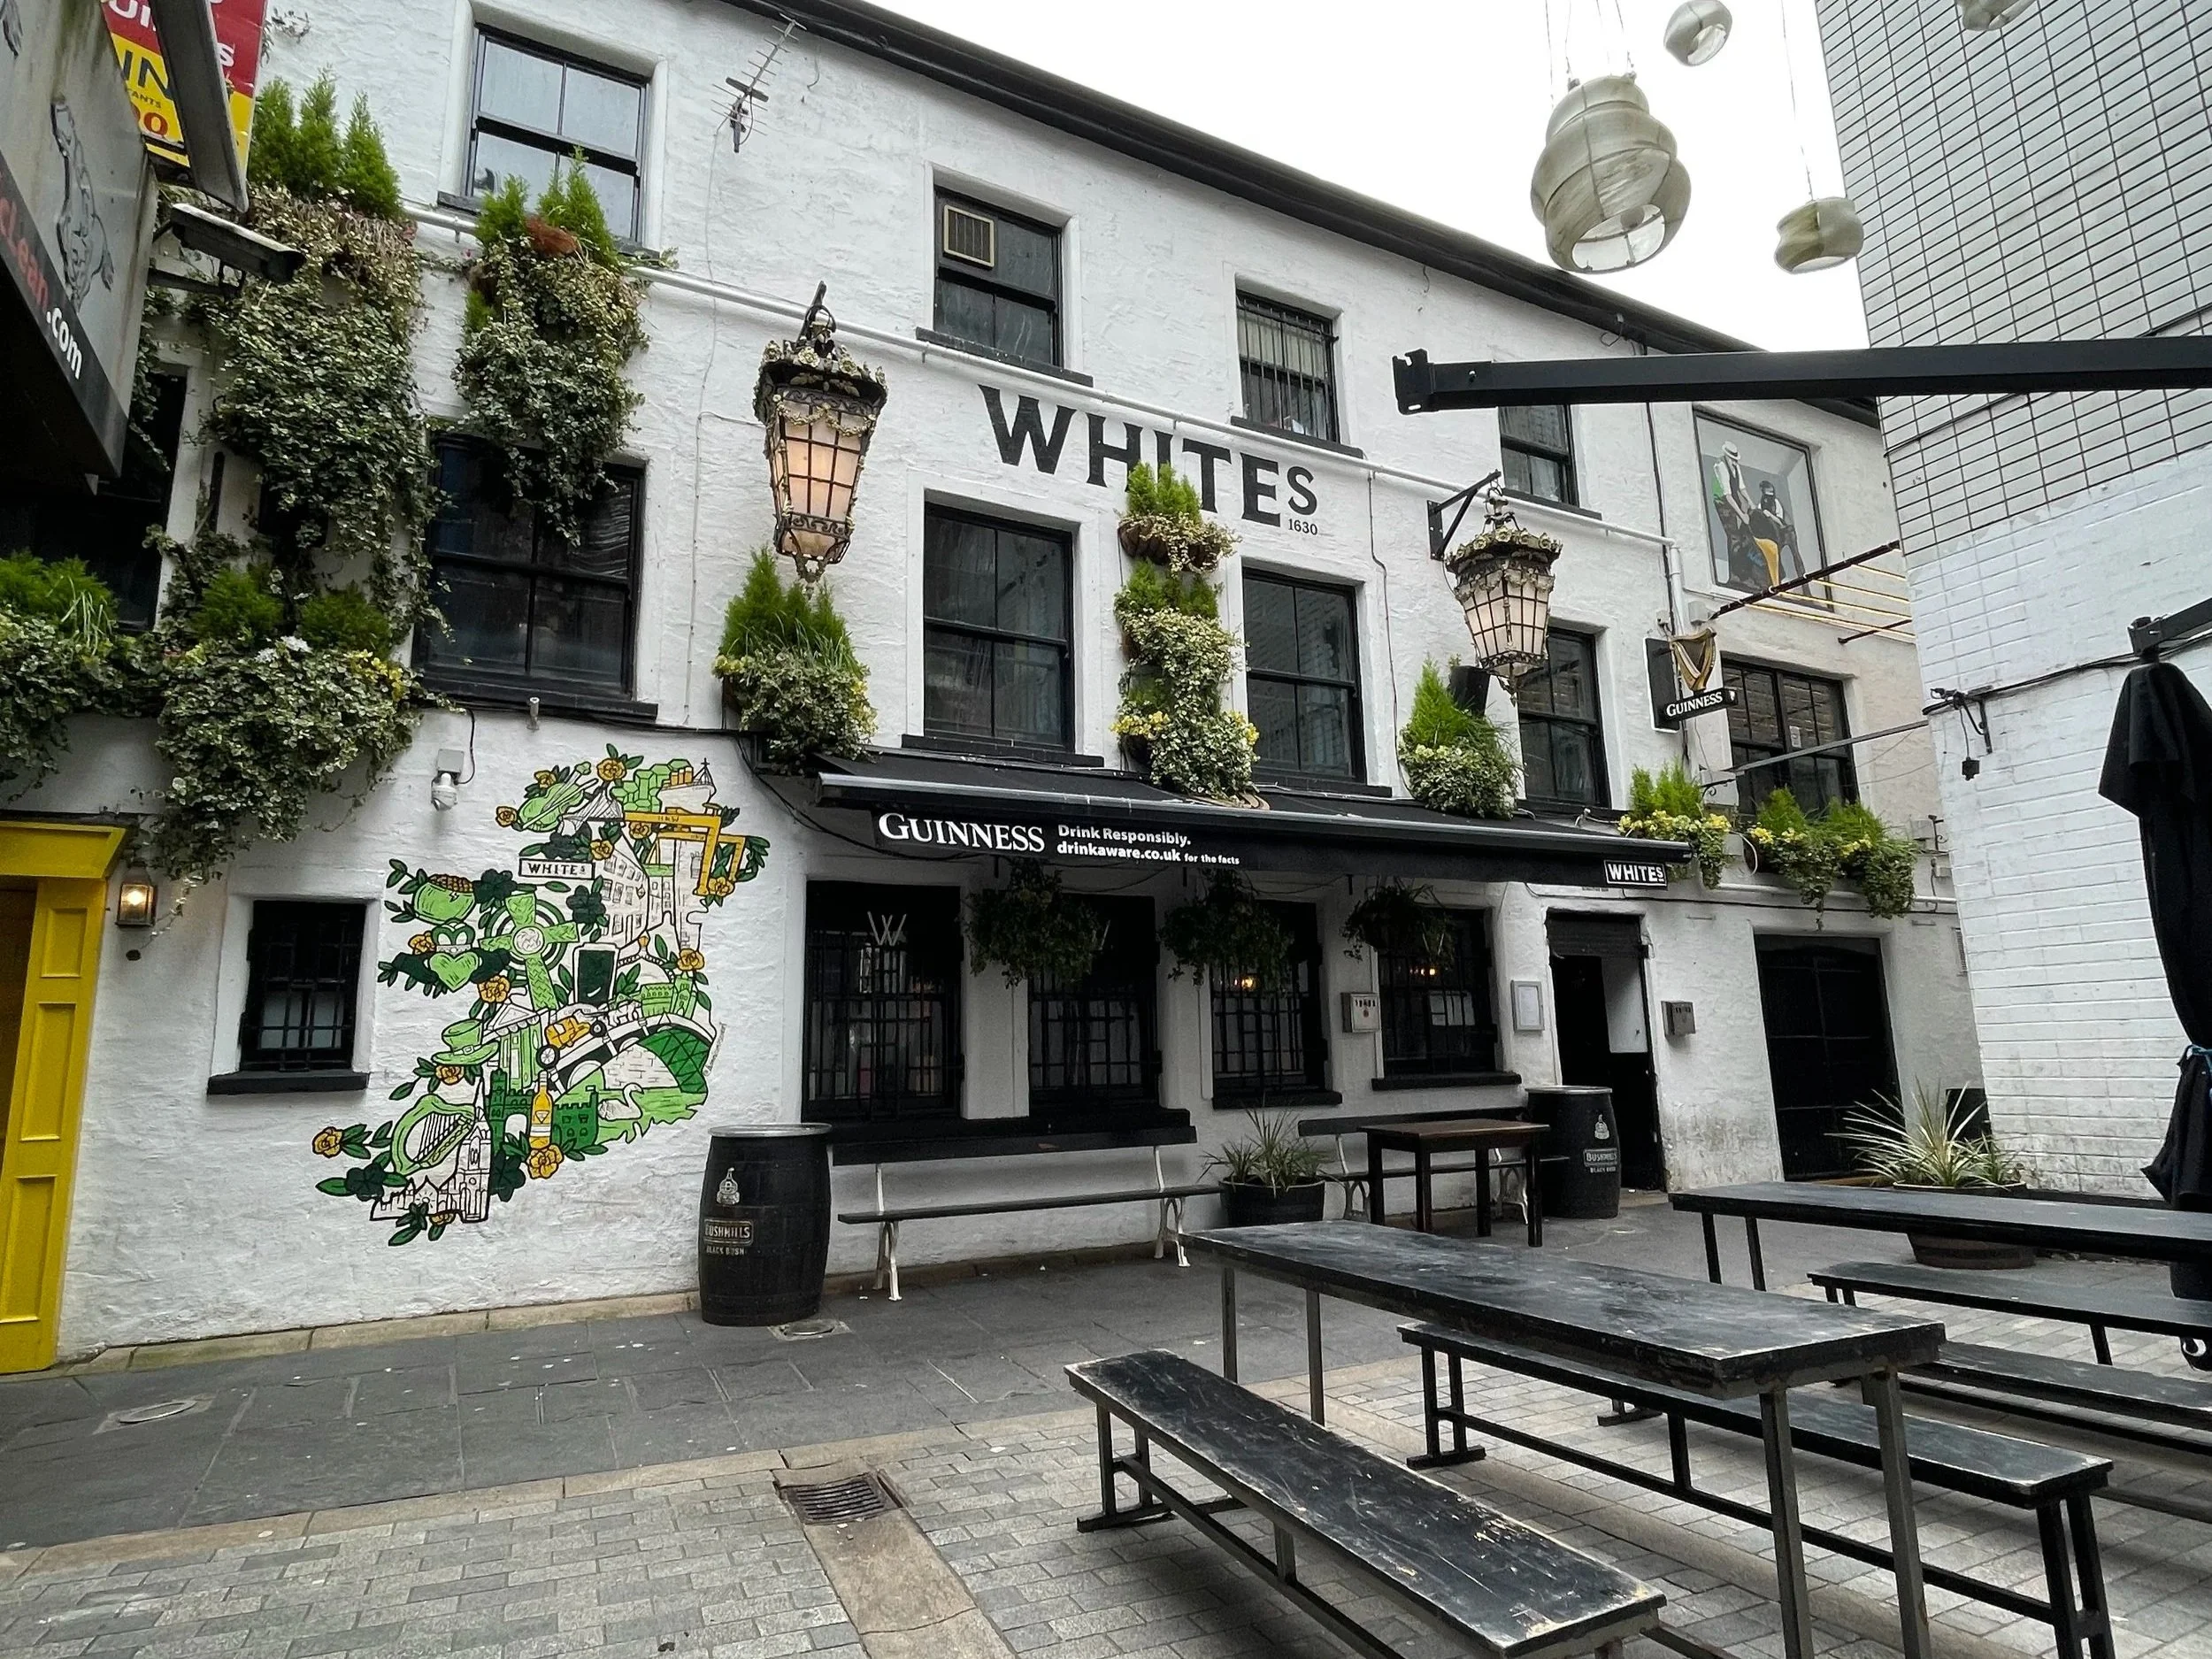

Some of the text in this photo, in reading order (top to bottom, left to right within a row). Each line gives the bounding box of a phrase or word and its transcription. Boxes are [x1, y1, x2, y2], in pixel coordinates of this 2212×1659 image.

[978, 384, 1318, 527] WHITES
[1288, 518, 1318, 535] 1630
[1666, 692, 1724, 717] GUINNESS
[878, 812, 1046, 853] GUINNESS
[1057, 824, 1192, 849] Drink Responsibly.
[1056, 841, 1240, 865] drinkaware.co.uk for the facts
[1607, 864, 1666, 882] WHITES
